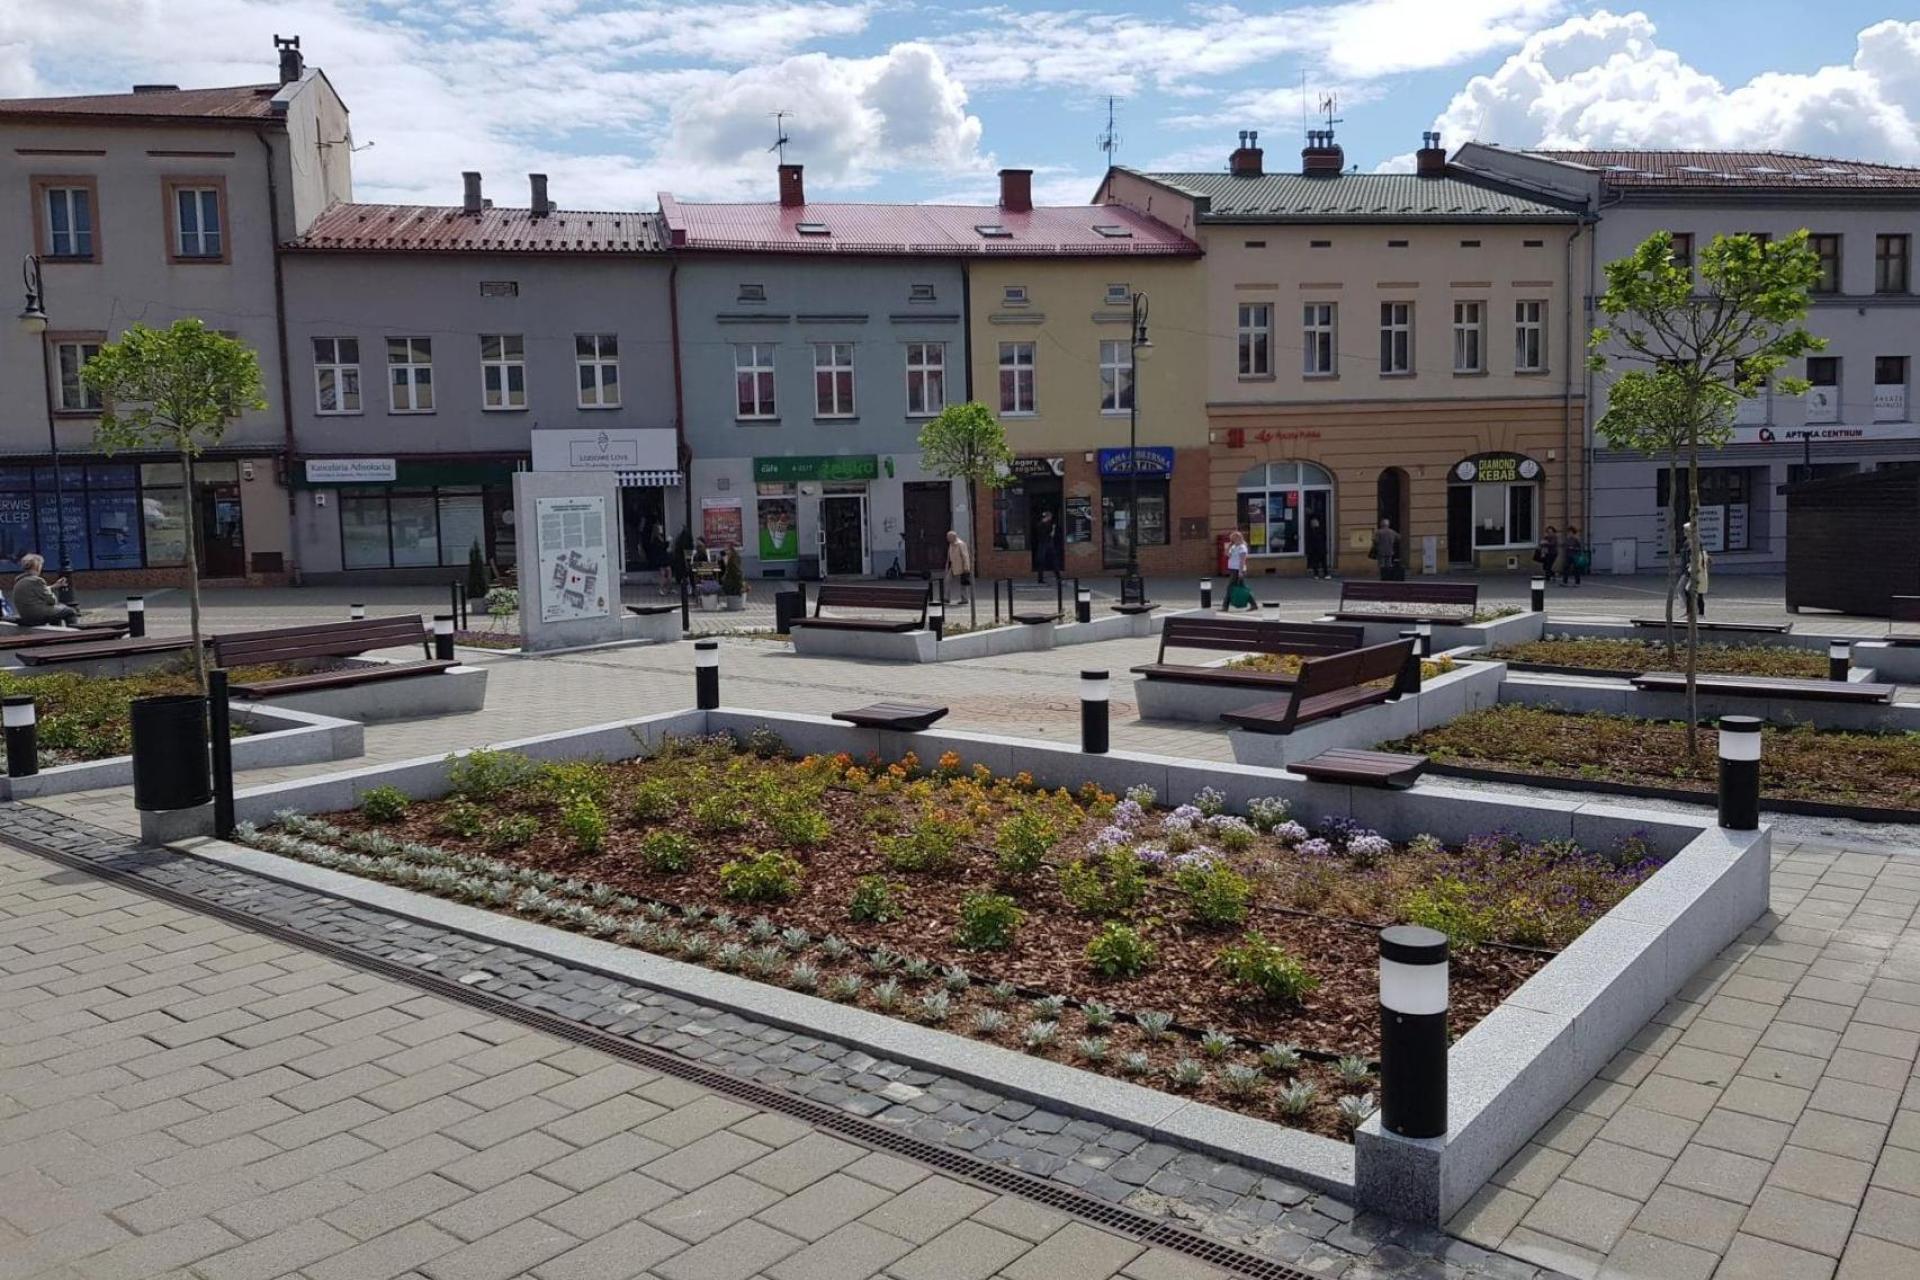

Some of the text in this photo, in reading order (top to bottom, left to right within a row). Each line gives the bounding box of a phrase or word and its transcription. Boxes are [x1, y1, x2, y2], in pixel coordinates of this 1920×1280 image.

[1821, 430, 1863, 438] CENTRUM
[1479, 459, 1516, 470] DIAMOND
[1479, 470, 1516, 480] KEBAB
